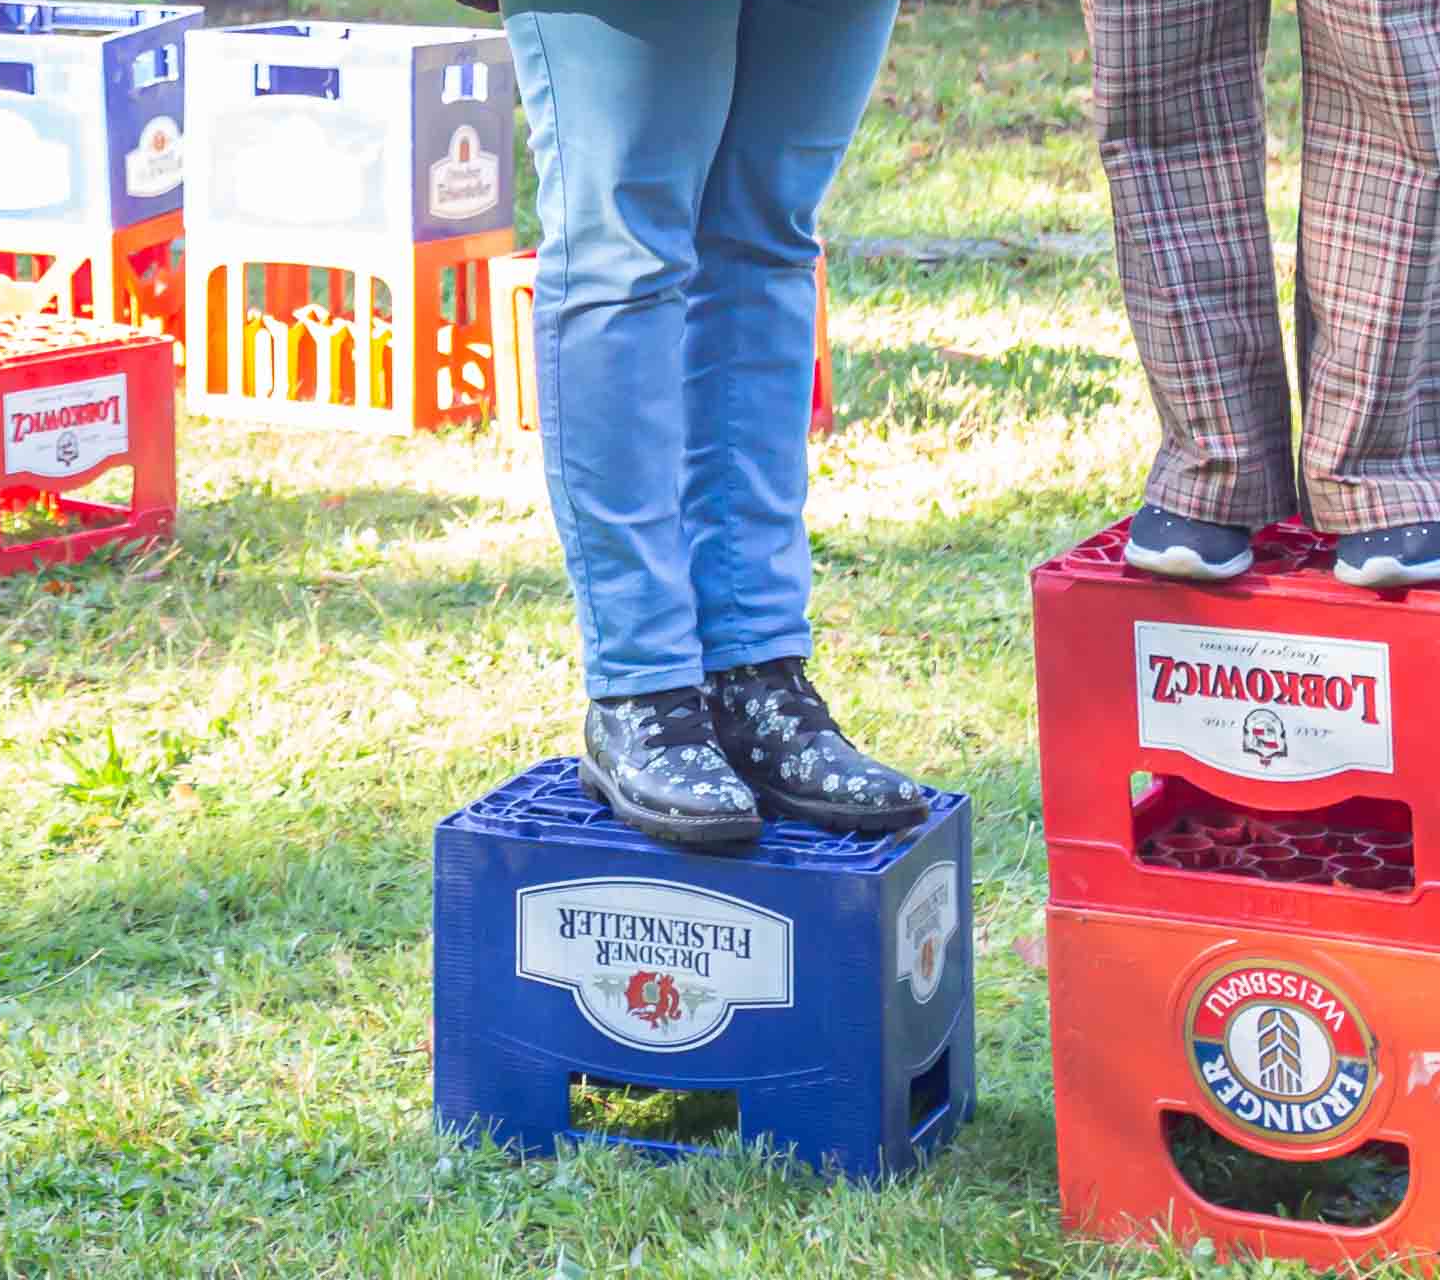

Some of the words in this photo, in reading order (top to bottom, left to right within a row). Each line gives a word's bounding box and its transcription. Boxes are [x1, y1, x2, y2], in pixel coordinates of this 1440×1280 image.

[12, 395, 121, 444] LOBKOWICZ
[1148, 654, 1381, 725] LOBKOWICZ
[557, 908, 752, 960] FELSENKELLER
[594, 939, 711, 978] DRESDNER
[1204, 971, 1345, 1033] WEISSBRÄU
[1201, 1054, 1363, 1133] ERDINGER
